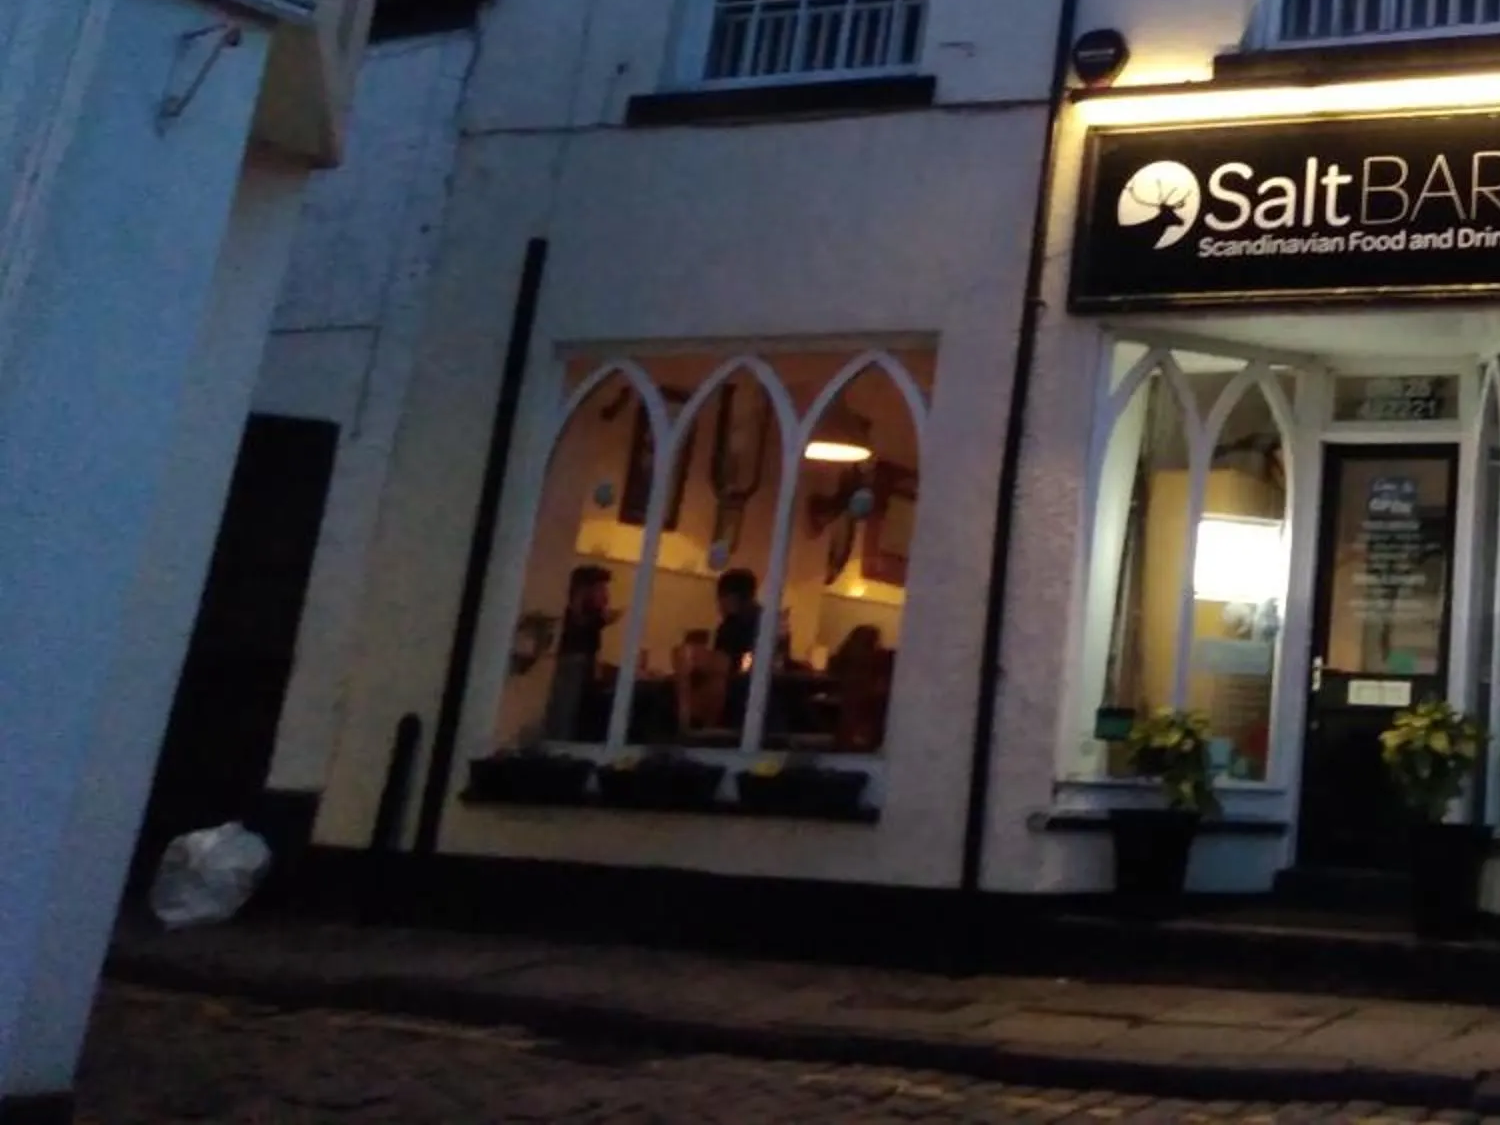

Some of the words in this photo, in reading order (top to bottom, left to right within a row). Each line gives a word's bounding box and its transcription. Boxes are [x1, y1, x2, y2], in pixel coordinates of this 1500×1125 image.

[1198, 231, 1345, 257] Scandinavian
[1349, 228, 1407, 252] Food
[1408, 226, 1454, 250] and
